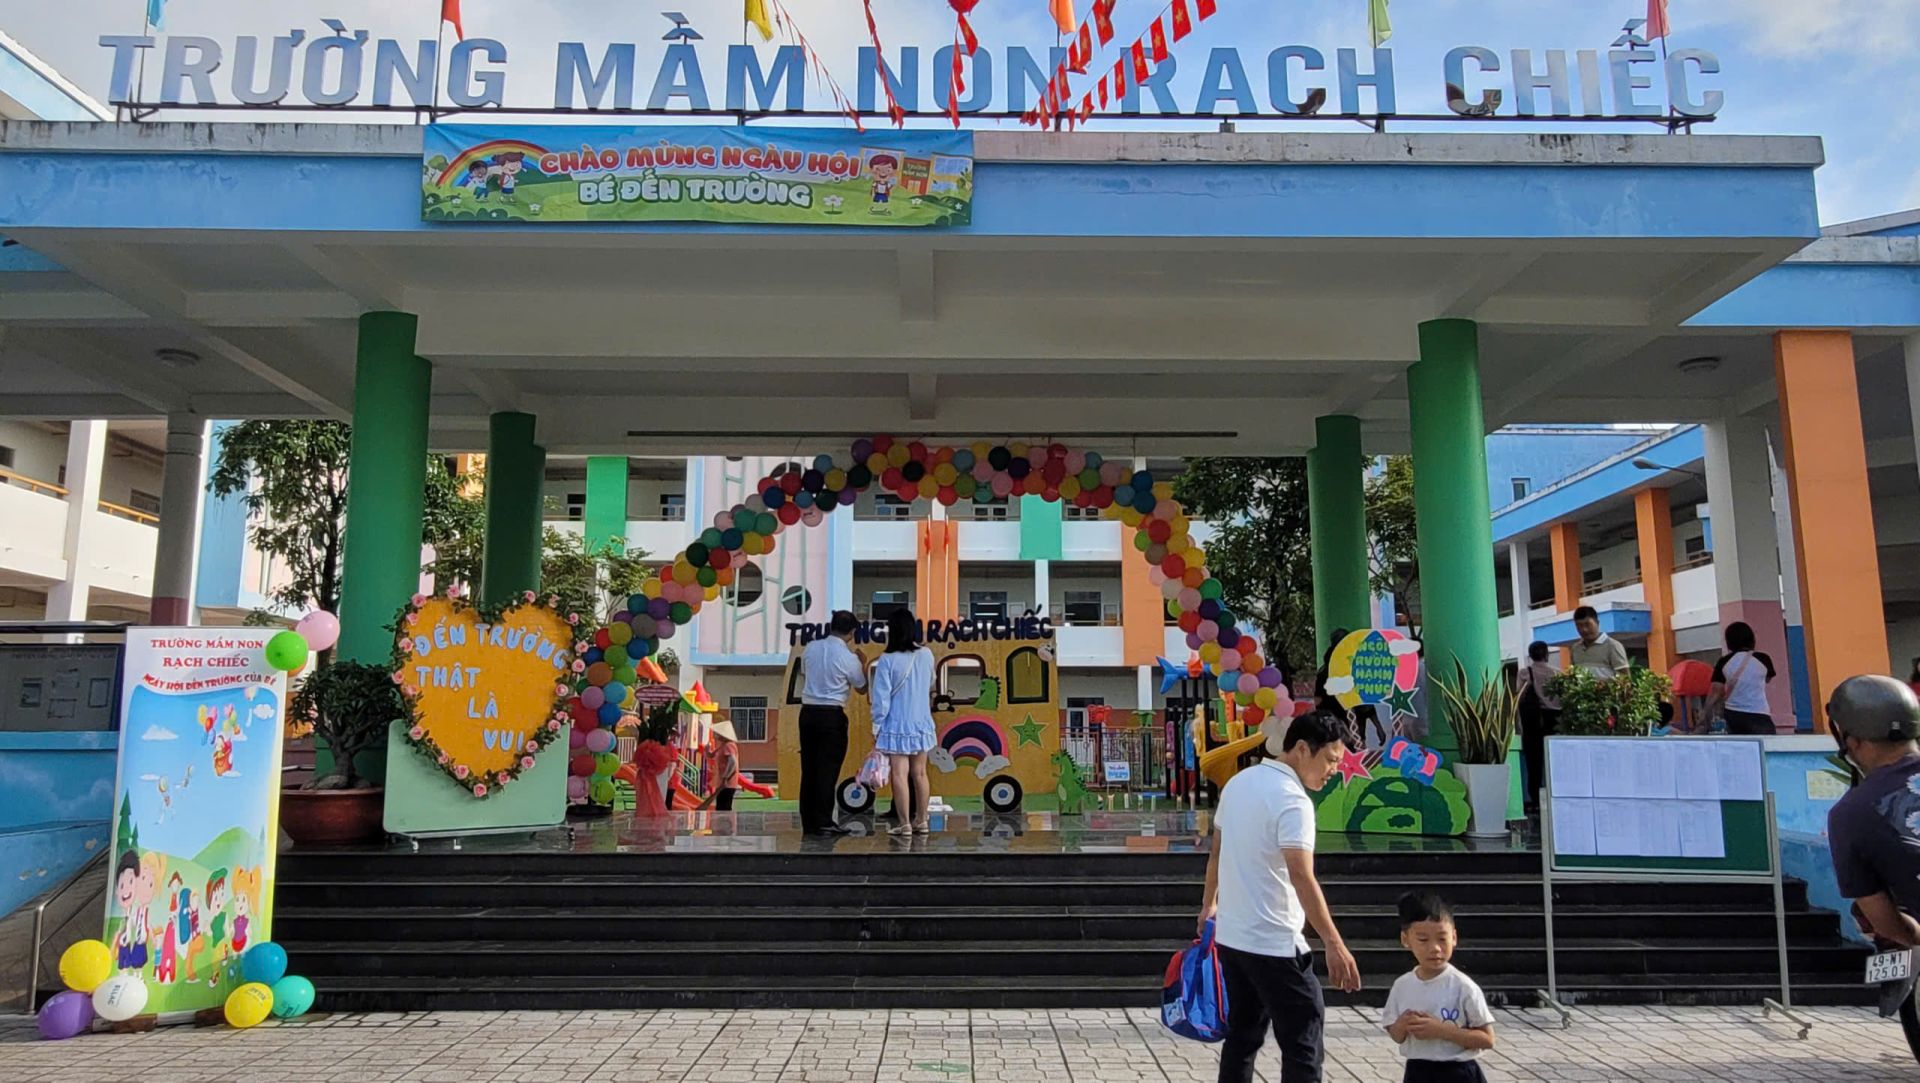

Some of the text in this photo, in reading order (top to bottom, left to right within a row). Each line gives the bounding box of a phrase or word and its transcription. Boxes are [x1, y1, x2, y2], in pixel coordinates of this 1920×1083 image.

[98, 18, 508, 109] TRƯỜNG
[554, 11, 805, 112] MẦM
[856, 44, 1068, 114] NON
[1443, 18, 1724, 118] CHIẾC
[540, 144, 620, 174] CHÀO
[721, 143, 803, 172] NGÀY
[807, 151, 861, 182] HỘI
[579, 169, 812, 208] BÉ ĐẾN TRƯỜNG
[151, 635, 201, 649] TRƯỜNG
[238, 639, 264, 649] NON
[414, 616, 570, 670] ĐẾN TRƯỜNG
[927, 618, 989, 649] RẠCH
[990, 604, 1053, 640] CHIẾC
[163, 653, 250, 670] RẠCH CHIẾC
[415, 662, 482, 692] THẬT
[467, 690, 499, 719] LÀ
[1872, 953, 1902, 967] 49-N1
